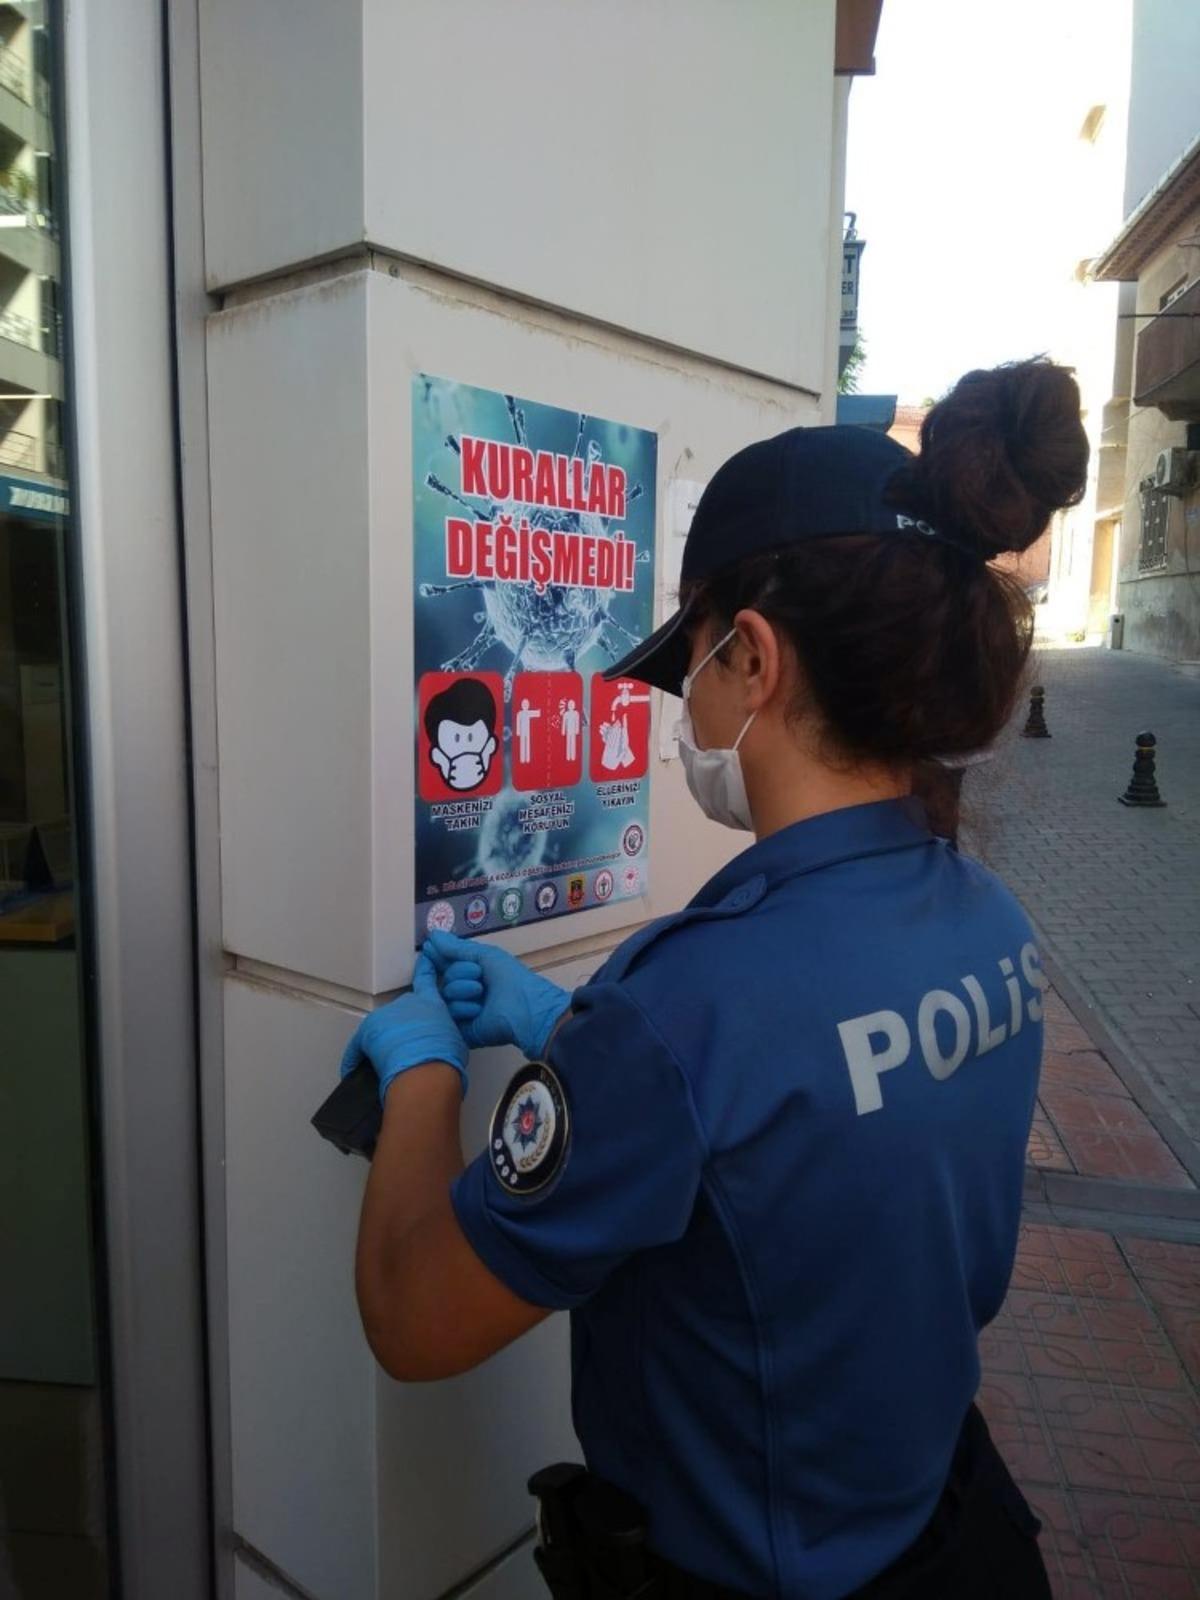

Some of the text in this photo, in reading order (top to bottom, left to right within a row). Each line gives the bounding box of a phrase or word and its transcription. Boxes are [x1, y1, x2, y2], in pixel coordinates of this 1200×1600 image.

[460, 436, 627, 520] KURALLAR
[446, 515, 635, 594] DEĞİŞMEDİ!
[531, 792, 565, 805] SOSYAL
[446, 816, 480, 831] TAKIN
